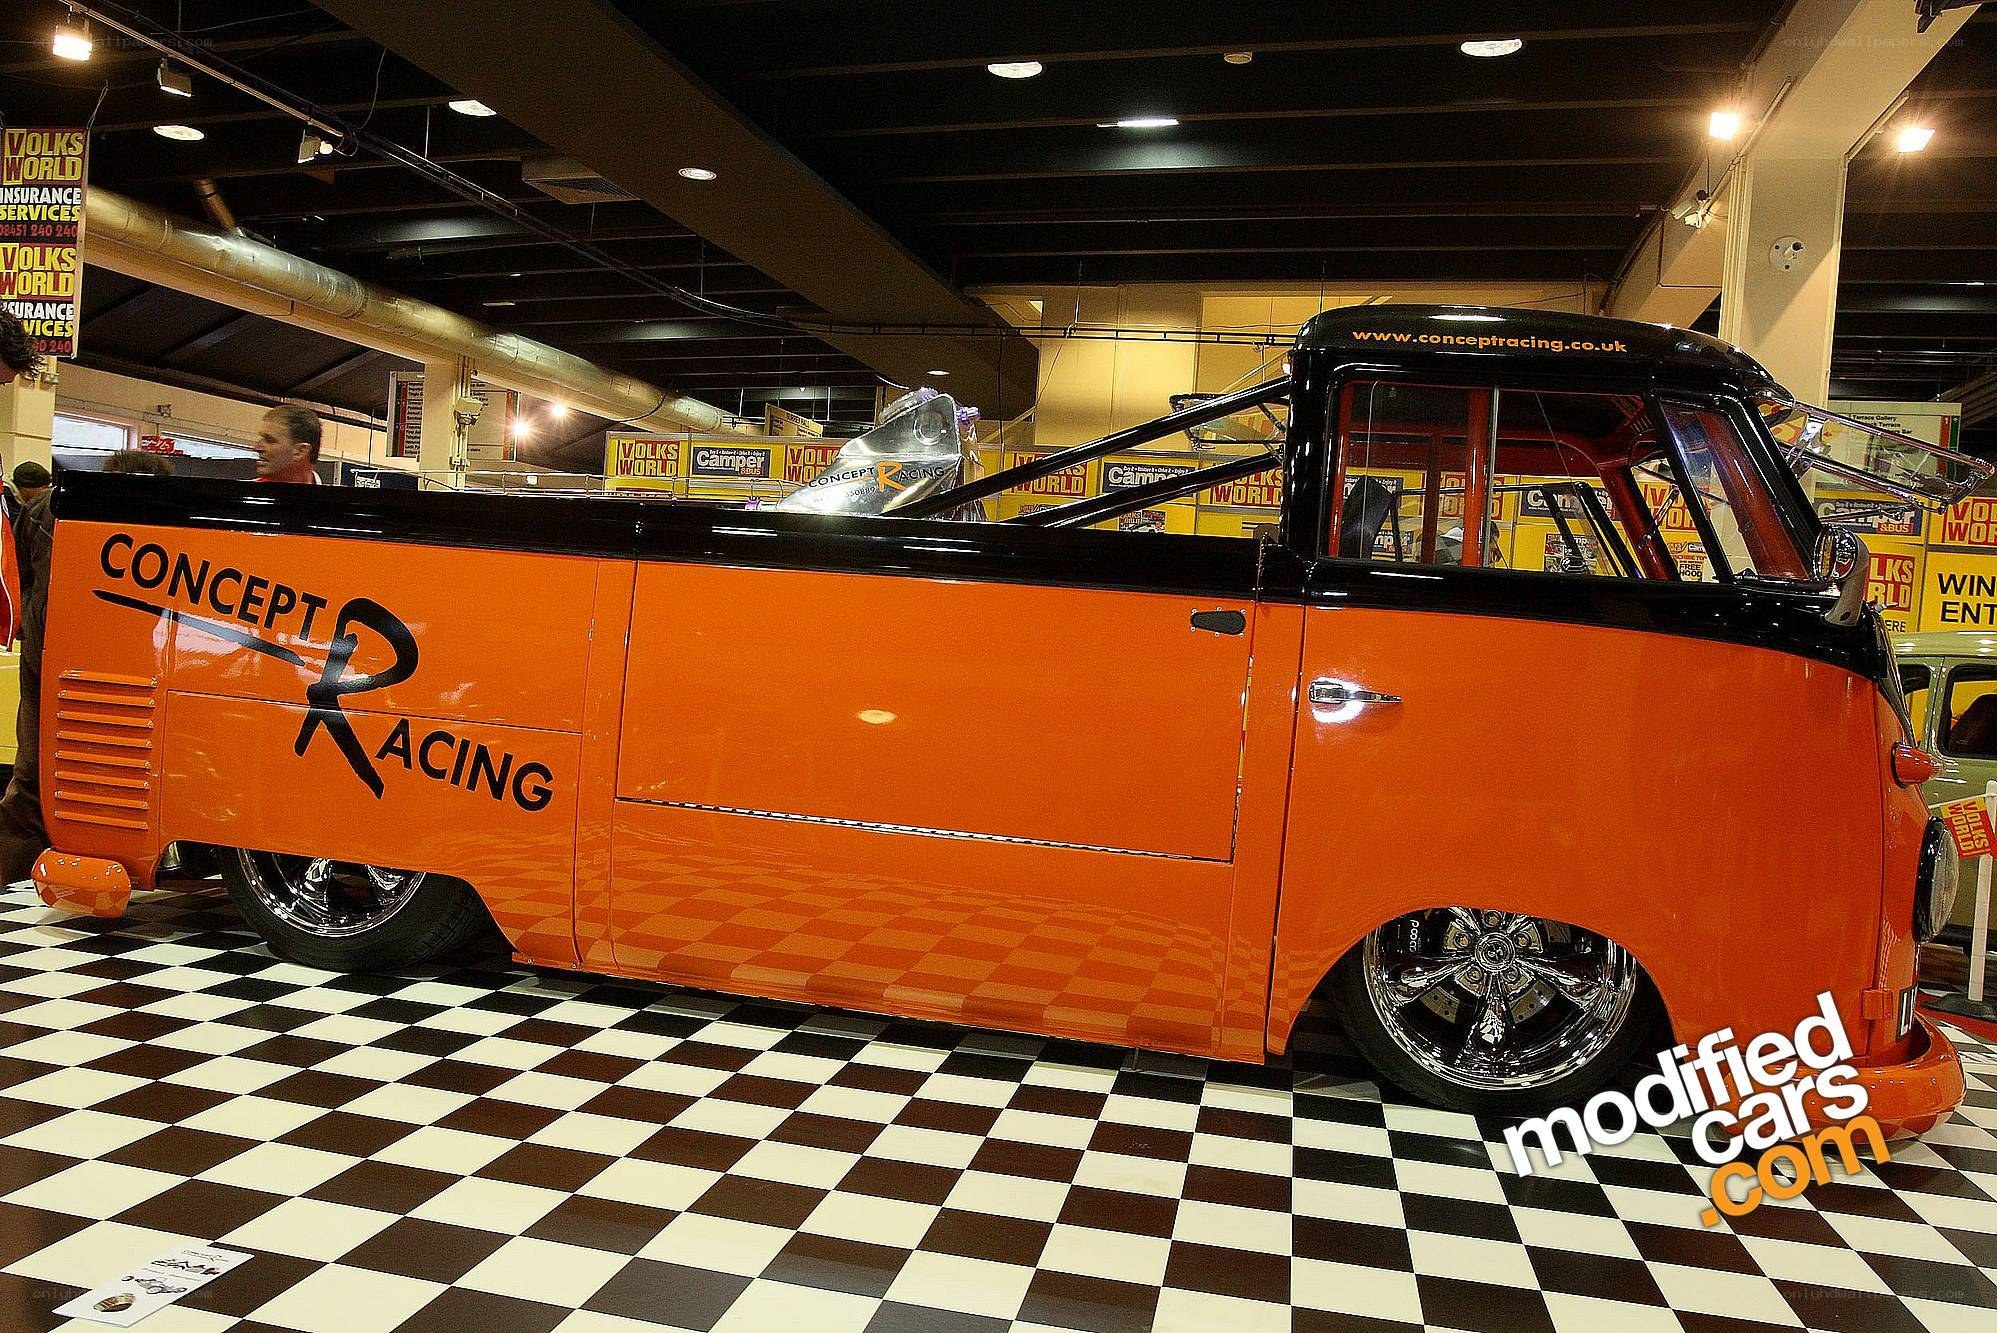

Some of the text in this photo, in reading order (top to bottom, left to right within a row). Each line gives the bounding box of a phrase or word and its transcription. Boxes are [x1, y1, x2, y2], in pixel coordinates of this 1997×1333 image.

[6, 131, 84, 156] VOLKS
[5, 156, 83, 181] WORLD
[0, 187, 81, 204] INSURANCE
[0, 204, 80, 221] SERVICES
[1, 246, 76, 271] VOLKS
[0, 271, 74, 296] WORLD
[23, 320, 73, 337] VICES
[1352, 331, 1628, 352] www.conceptracing.co.uk
[621, 442, 678, 460] VOLKS
[697, 451, 765, 471] Camper
[789, 448, 839, 465] VOLK
[620, 460, 677, 476] WORLD
[808, 467, 875, 488] CONCEPT
[1108, 466, 1178, 484] Camp
[1880, 523, 1909, 533] &BUS
[1869, 557, 1914, 583] LKS
[1867, 582, 1911, 608] RLD
[1937, 572, 1997, 597] WIN
[1940, 601, 1997, 625] ENT
[1884, 620, 1906, 633] ERE
[99, 532, 554, 812] CONCEPT RACING
[1947, 802, 1976, 852] WORLD
[1962, 799, 1989, 850] VOLKS
